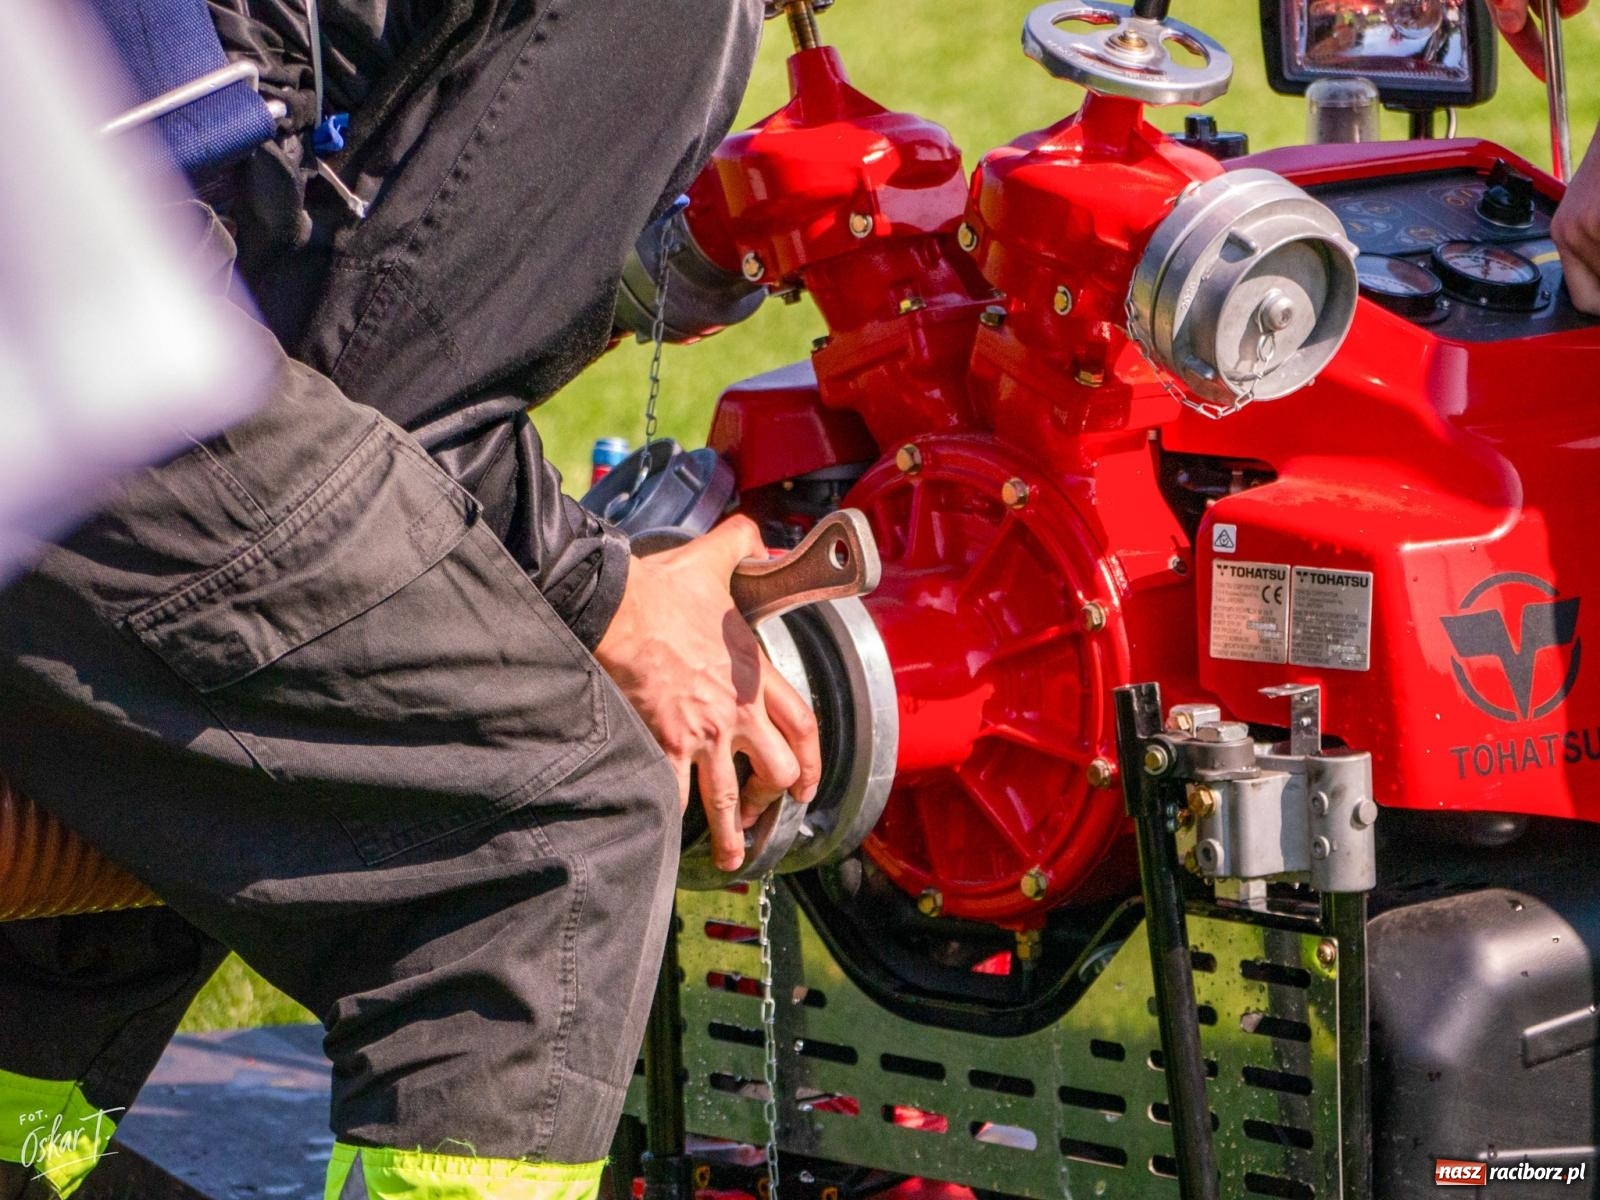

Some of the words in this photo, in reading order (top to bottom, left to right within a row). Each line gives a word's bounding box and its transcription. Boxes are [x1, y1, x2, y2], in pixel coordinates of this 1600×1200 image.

[1230, 566, 1286, 581] TOHATSU
[1310, 572, 1369, 588] TOHATSU
[1450, 728, 1600, 780] TOHATSU
